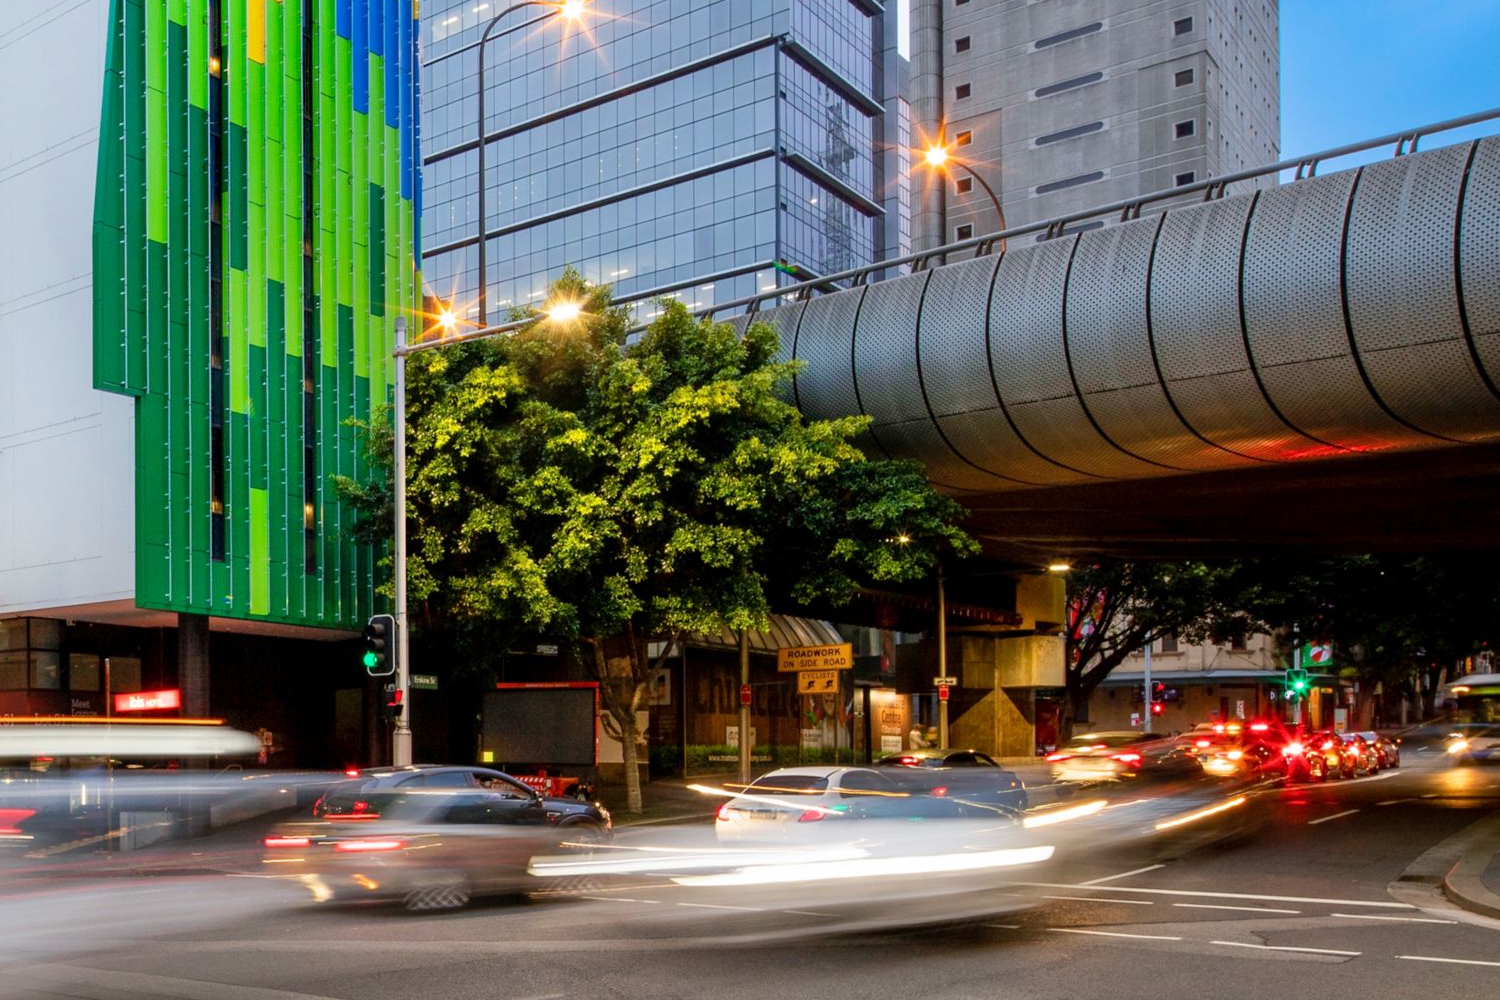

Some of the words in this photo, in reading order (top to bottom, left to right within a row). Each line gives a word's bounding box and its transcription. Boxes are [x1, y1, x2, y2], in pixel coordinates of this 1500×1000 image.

[787, 648, 841, 658] ROADWORK
[783, 660, 794, 669] ON
[800, 659, 818, 668] SIDE
[823, 657, 846, 667] ROAD
[802, 671, 835, 679] CYCLISTS
[128, 696, 145, 708] ibis
